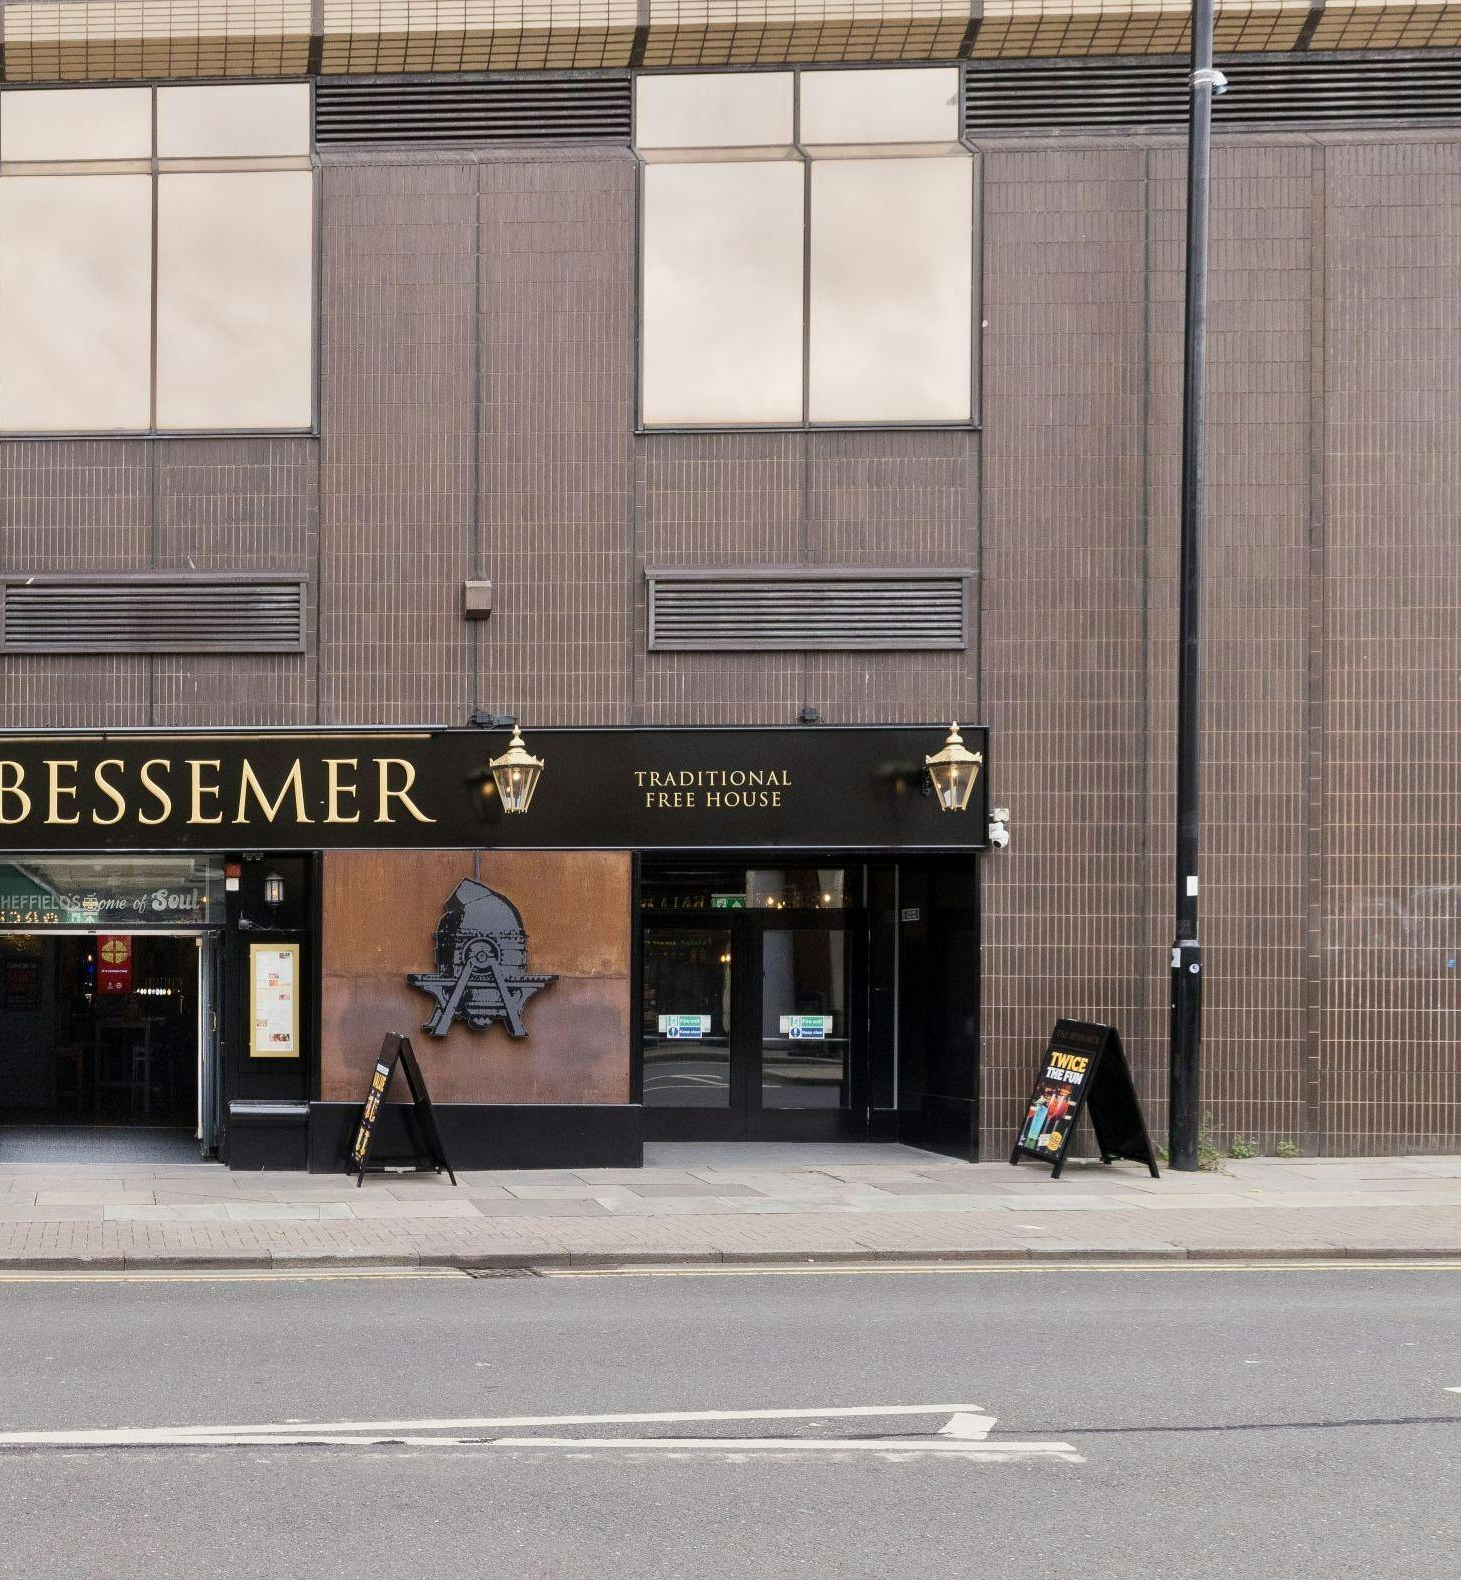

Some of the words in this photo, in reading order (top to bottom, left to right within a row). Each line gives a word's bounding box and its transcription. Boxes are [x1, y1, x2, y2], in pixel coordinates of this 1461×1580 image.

[634, 770, 792, 787] TRADITIONAL
[645, 792, 695, 808] FREE
[706, 791, 782, 807] HOUSE
[133, 894, 148, 913] of
[151, 888, 201, 912] Soul
[1049, 1051, 1089, 1074] TWICE
[1046, 1066, 1064, 1082] THE
[1064, 1072, 1084, 1085] FUN
